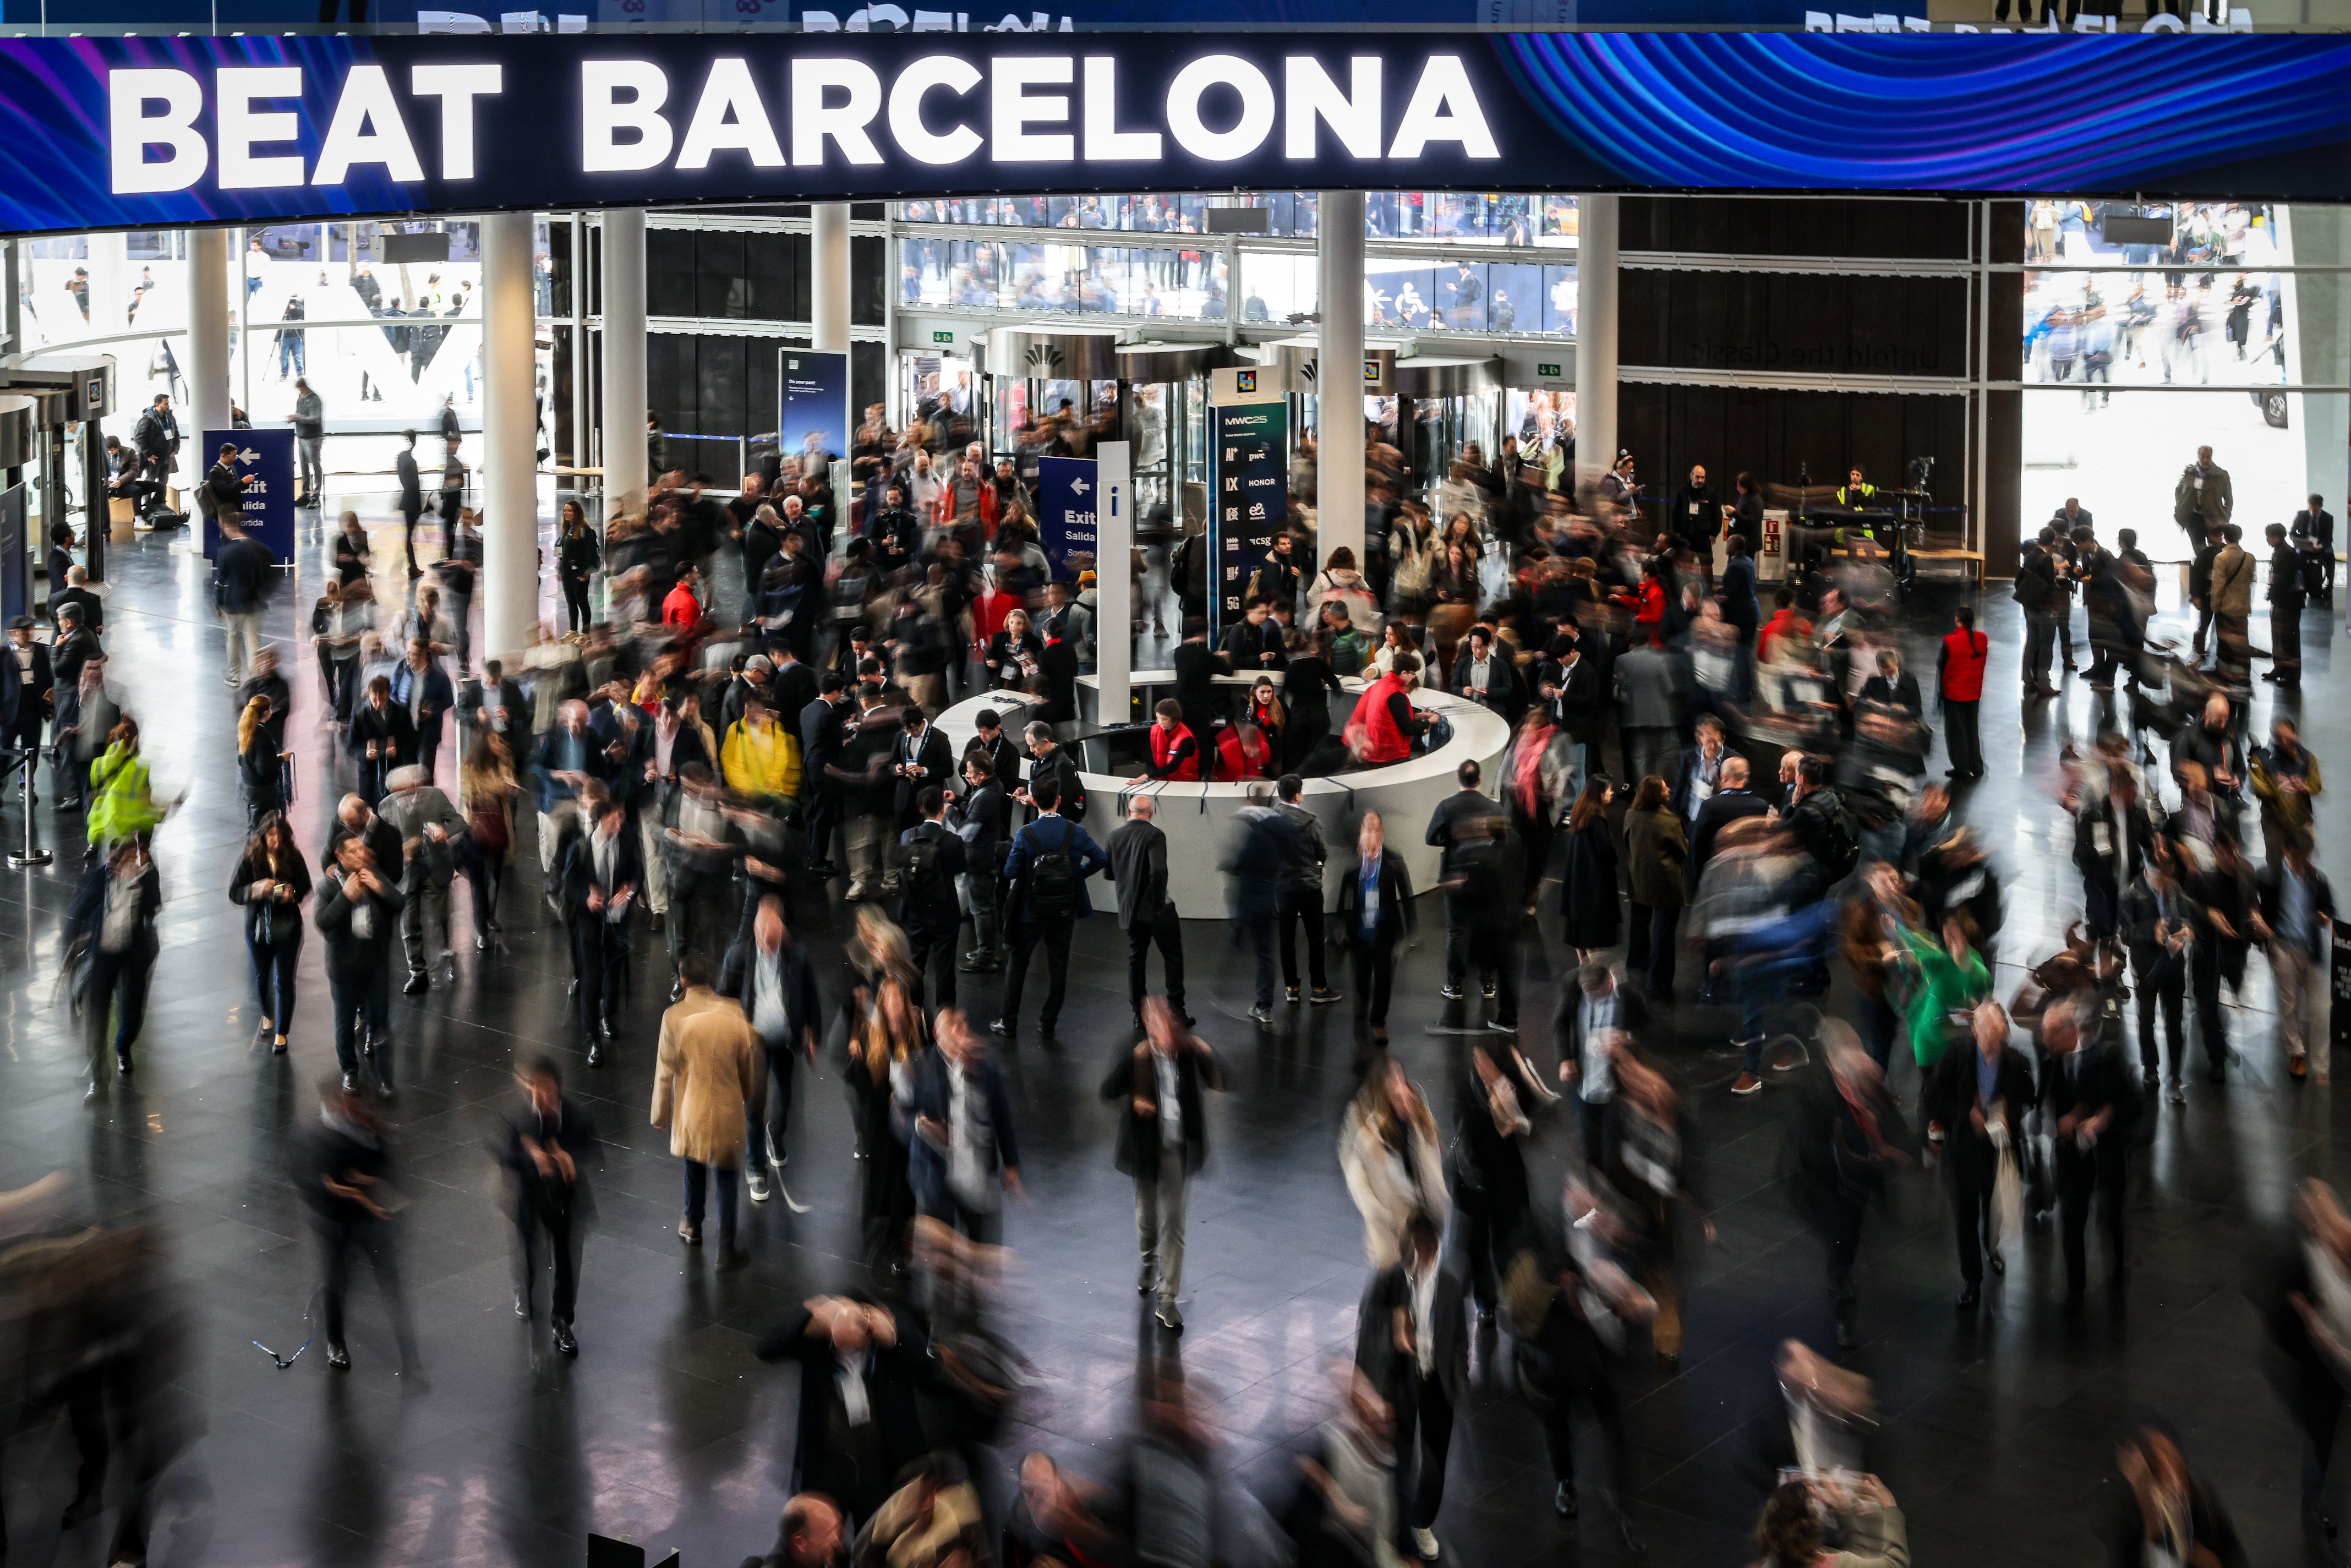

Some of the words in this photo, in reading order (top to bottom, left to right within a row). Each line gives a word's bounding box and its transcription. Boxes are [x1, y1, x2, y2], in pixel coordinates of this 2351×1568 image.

[110, 65, 501, 193] BEAT
[583, 55, 1499, 171] BARCELONA
[1225, 416, 1267, 425] MWC25
[1249, 451, 1265, 462] pwc
[240, 480, 267, 494] xit
[1249, 478, 1275, 487] HONOR
[242, 501, 266, 510] lida
[1064, 510, 1096, 525] Exit
[1065, 531, 1095, 542] Salida
[1256, 537, 1271, 546] csg
[1227, 596, 1239, 610] 5G
